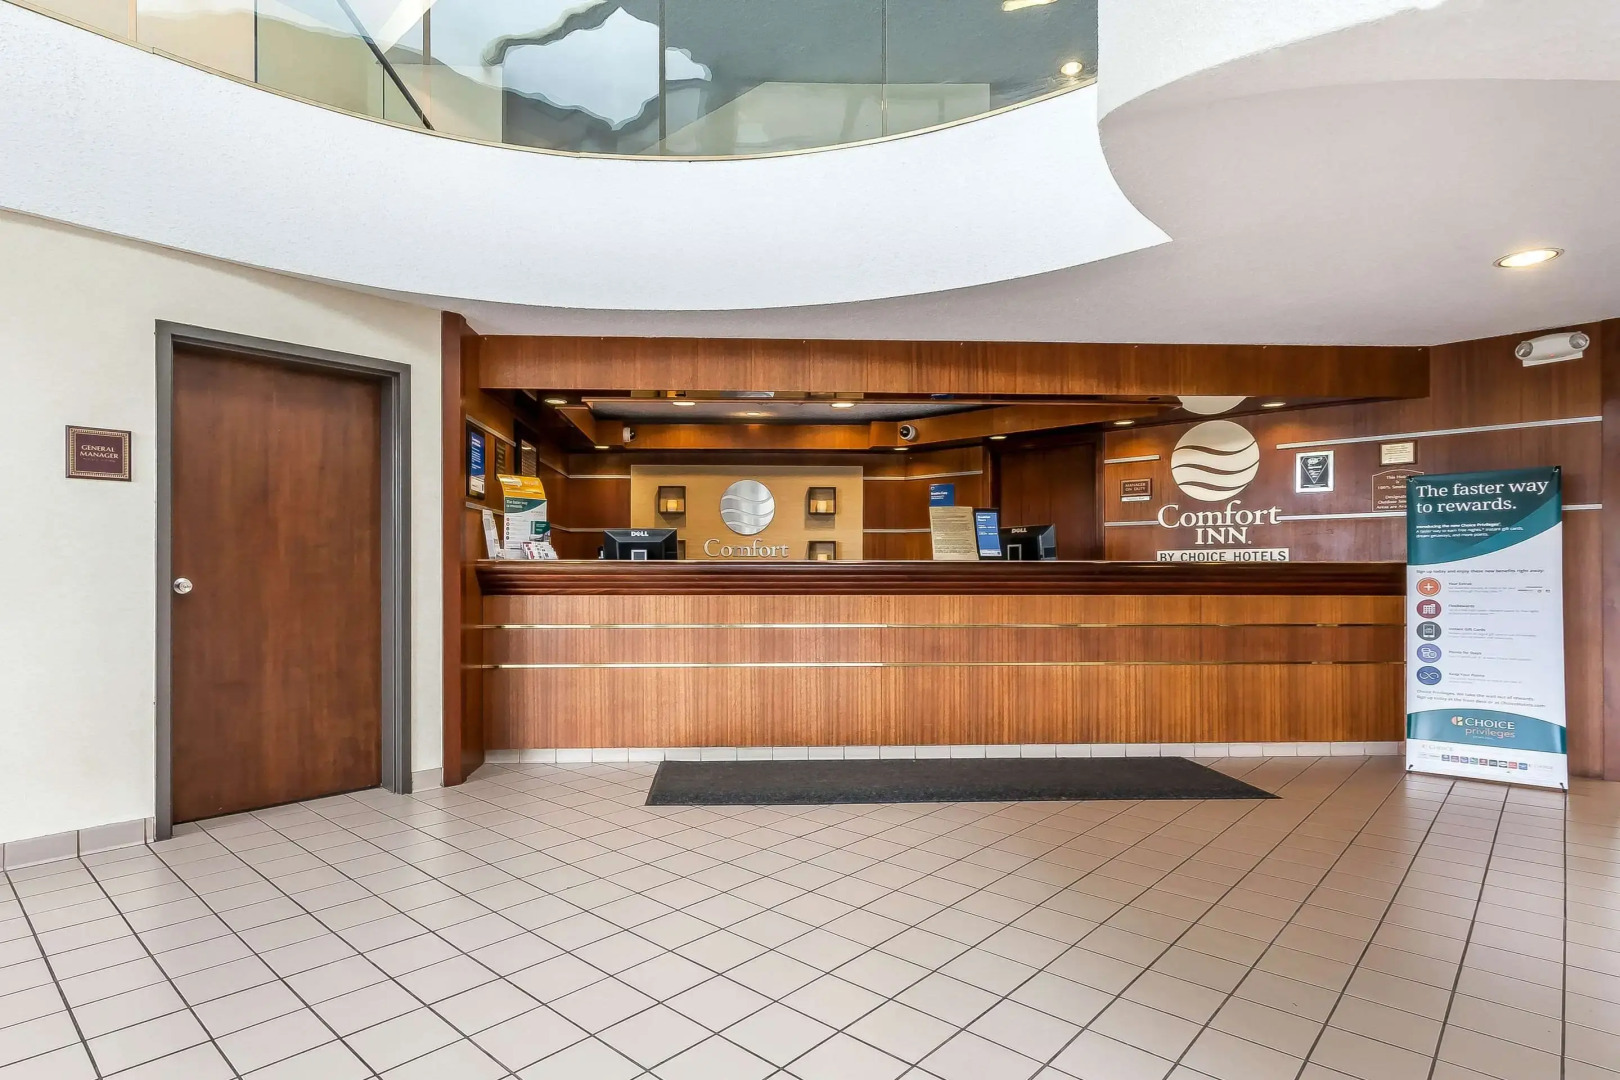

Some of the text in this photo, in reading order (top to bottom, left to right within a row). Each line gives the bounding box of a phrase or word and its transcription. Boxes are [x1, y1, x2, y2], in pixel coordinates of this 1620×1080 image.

[80, 451, 119, 459] MANAGER
[1416, 481, 1549, 498] The faster way
[1416, 498, 1517, 514] to rewards.
[1158, 500, 1282, 528] Comfort
[704, 538, 789, 558] Comfort
[1160, 551, 1286, 561] BY CHOICE HOTELS
[1465, 718, 1515, 729] CHOICE
[1466, 728, 1515, 738] privileges
